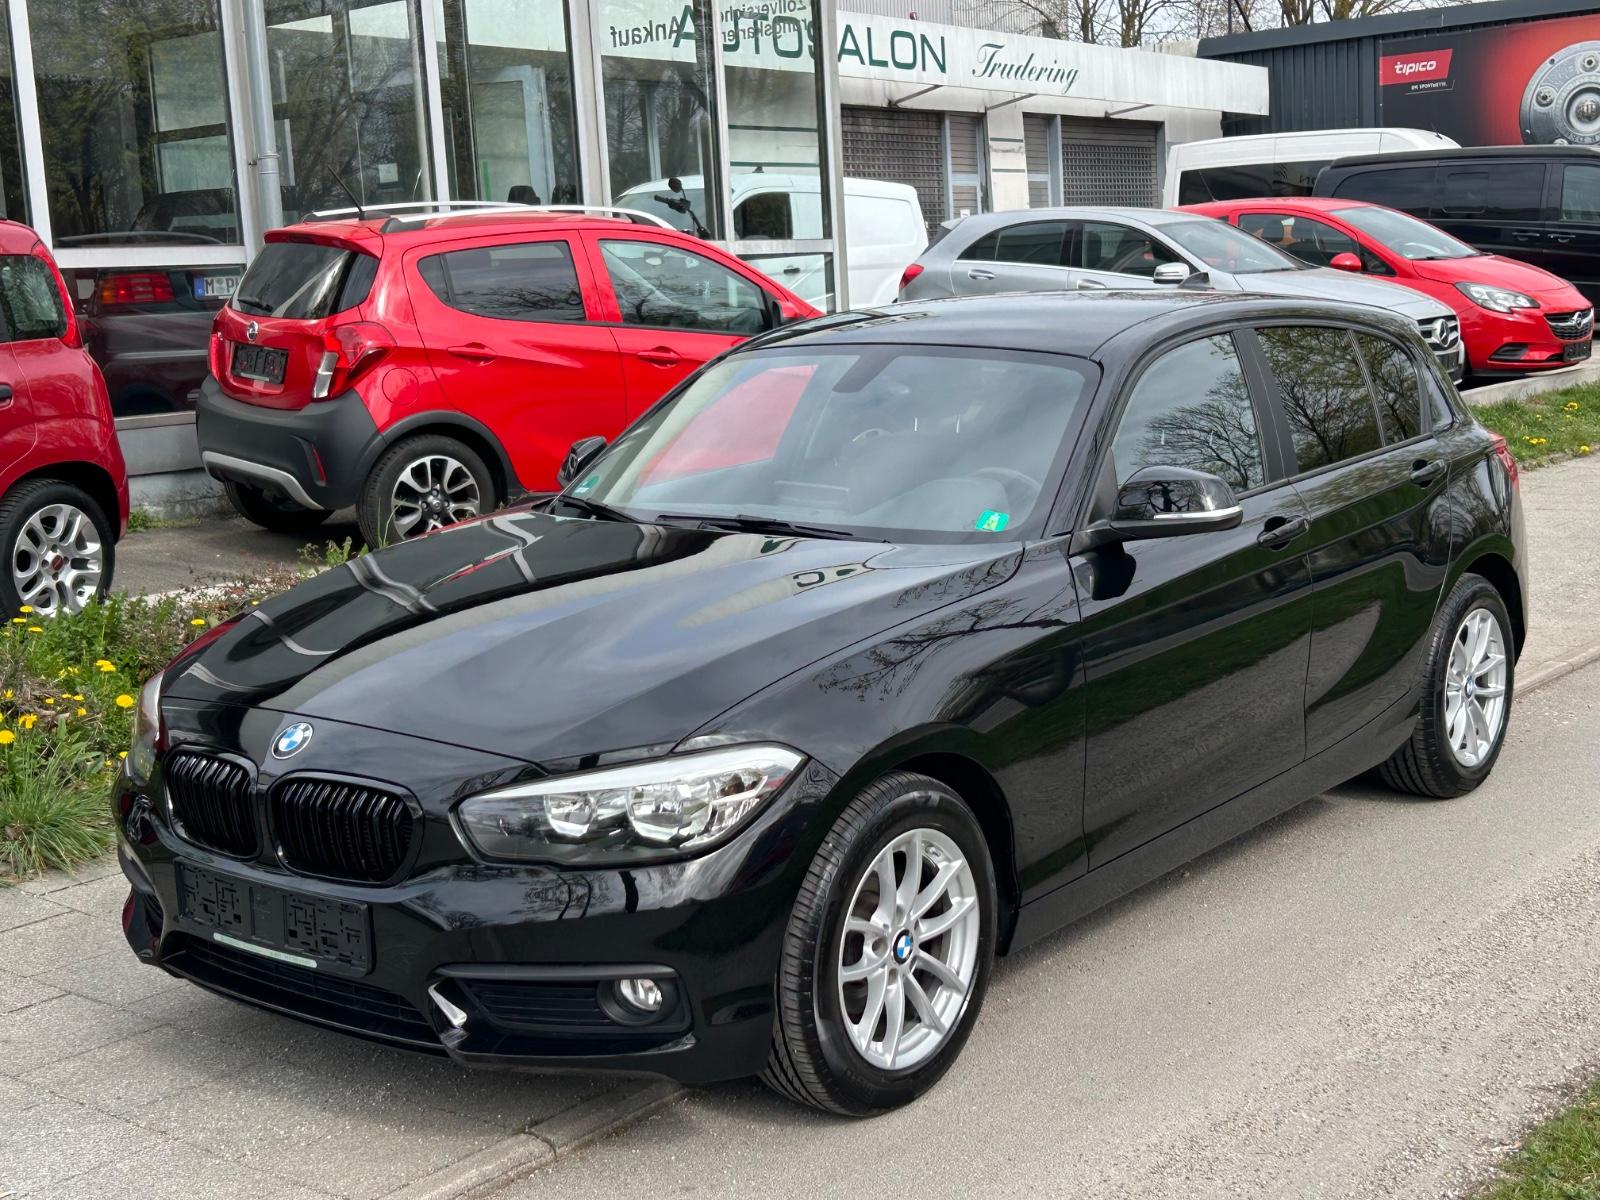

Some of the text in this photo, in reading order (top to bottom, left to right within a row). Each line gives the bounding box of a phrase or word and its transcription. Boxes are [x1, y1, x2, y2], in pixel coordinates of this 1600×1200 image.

[972, 43, 1078, 95] Trudering
[1394, 61, 1437, 75] tipico
[205, 278, 215, 294] M
